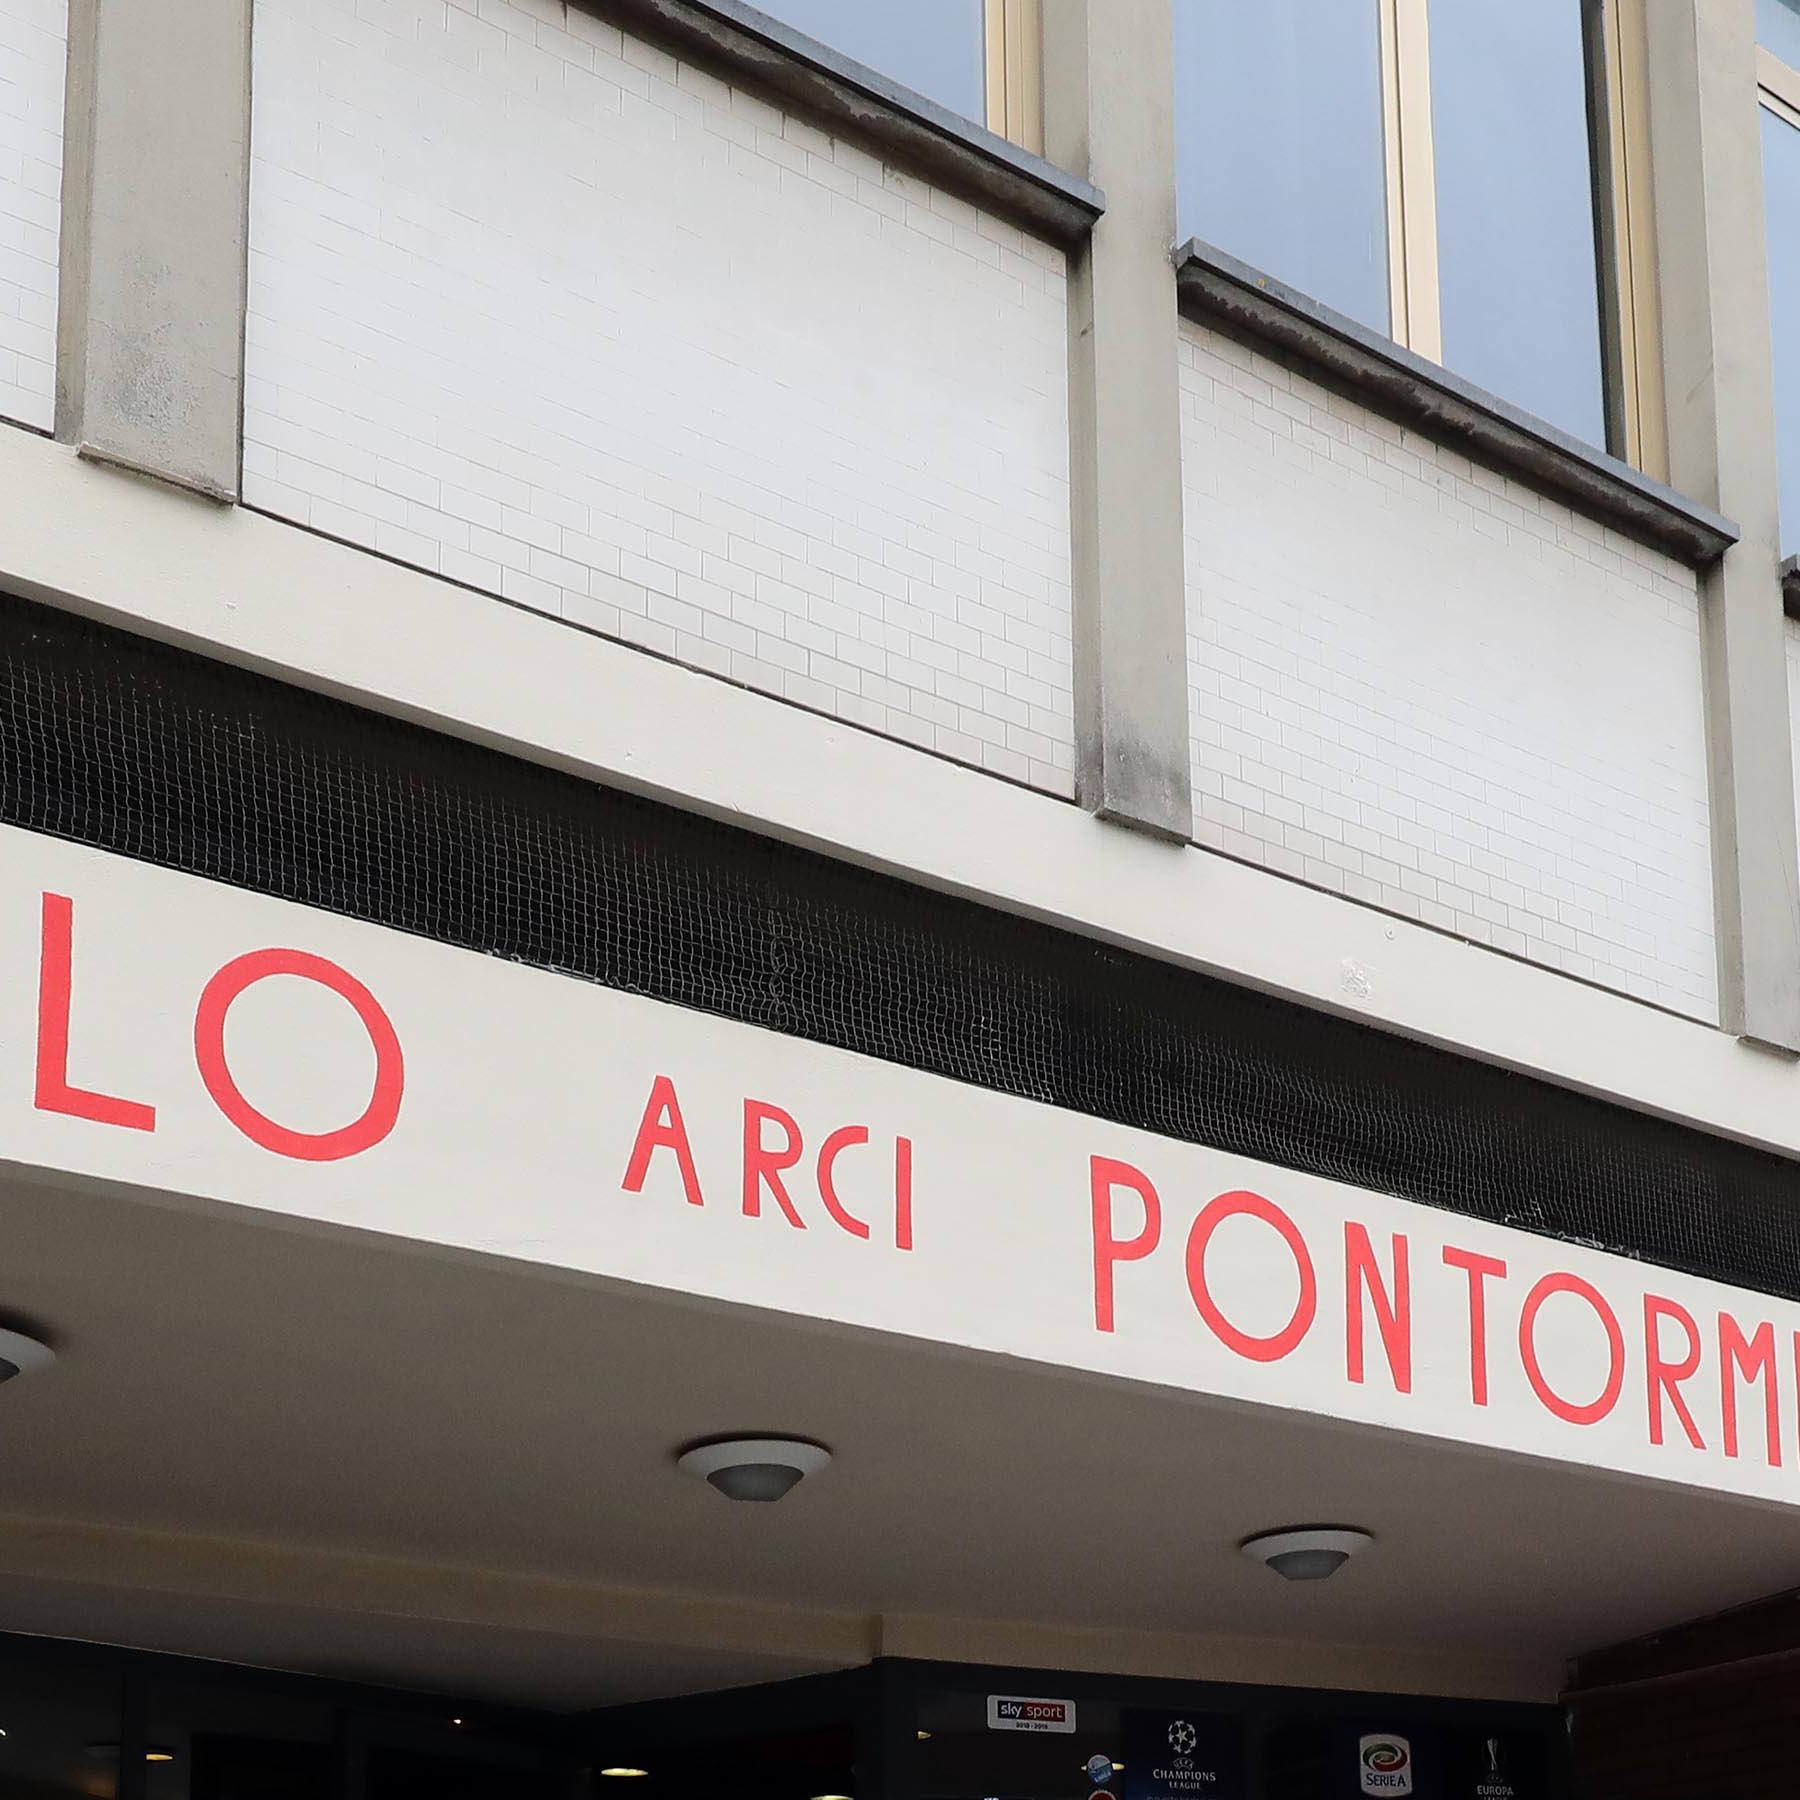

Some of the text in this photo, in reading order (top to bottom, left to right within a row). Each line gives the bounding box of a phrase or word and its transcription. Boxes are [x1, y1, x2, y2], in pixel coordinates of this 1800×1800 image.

[622, 1076, 914, 1251] ARCI
[999, 1702, 1063, 1719] sky sport
[1152, 1768, 1217, 1782] CHAMPIONS
[1169, 1781, 1201, 1791] LEAGUE
[1476, 1785, 1514, 1796] EUROPA
